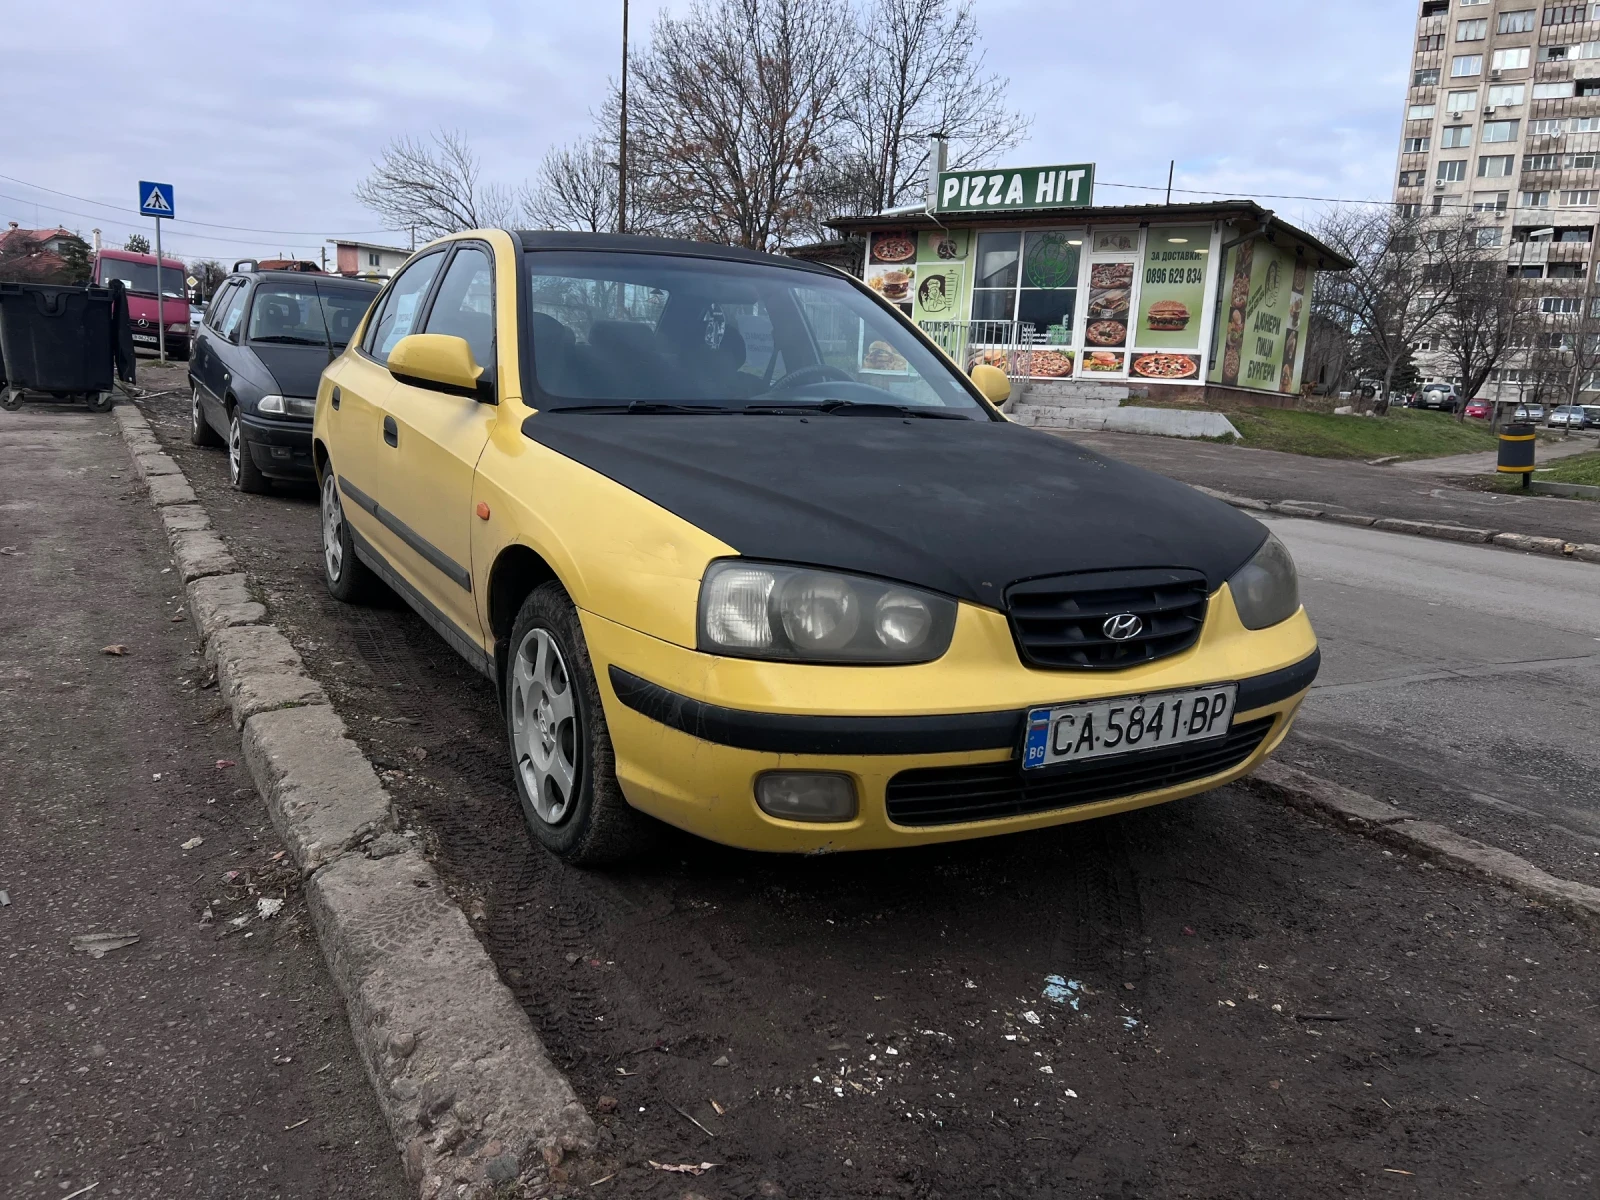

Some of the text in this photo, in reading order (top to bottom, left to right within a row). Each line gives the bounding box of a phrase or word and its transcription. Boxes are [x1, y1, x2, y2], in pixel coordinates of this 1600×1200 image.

[942, 170, 1086, 207] PIZZA HIT
[1151, 251, 1160, 260] ЗА
[1146, 267, 1202, 284] 0896 629 834
[1253, 310, 1281, 336] ДЮНЕРИ
[1255, 336, 1274, 360] ПИЦИ
[1247, 360, 1276, 382] БУРГЕРИ
[1029, 746, 1044, 760] BG
